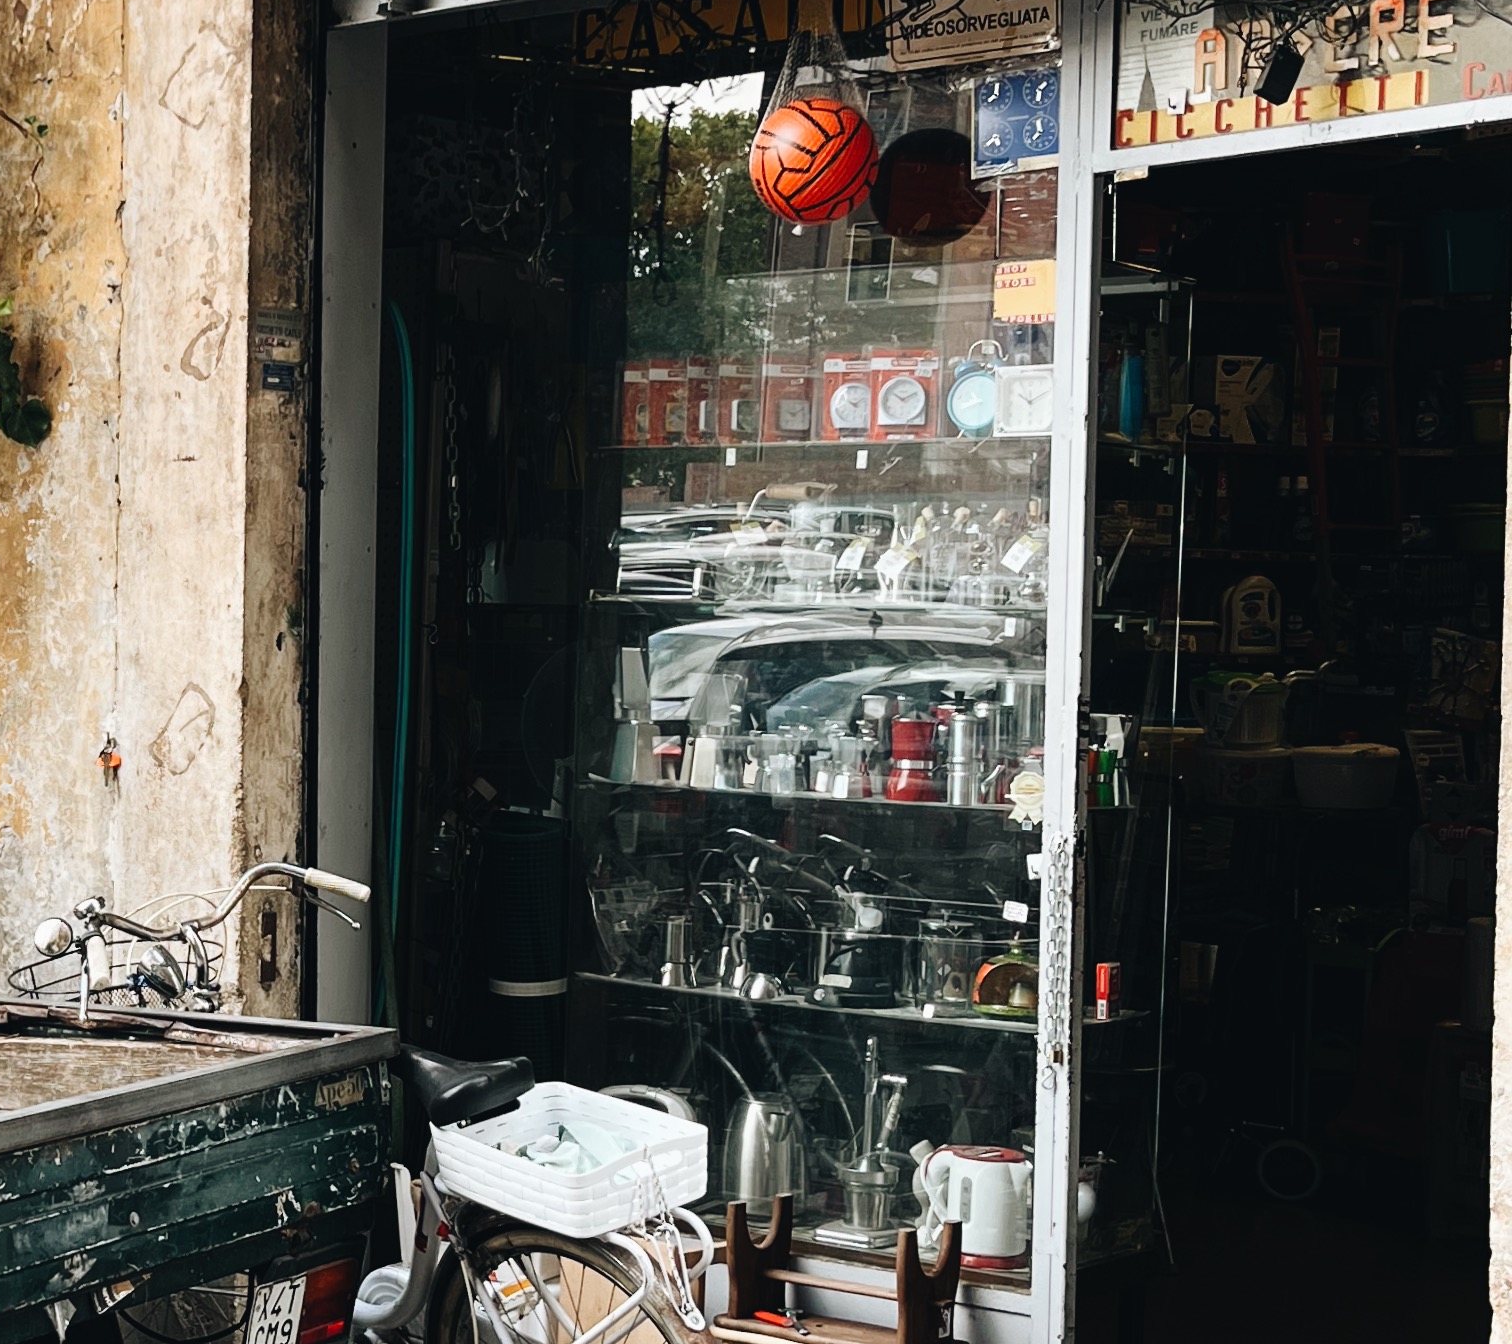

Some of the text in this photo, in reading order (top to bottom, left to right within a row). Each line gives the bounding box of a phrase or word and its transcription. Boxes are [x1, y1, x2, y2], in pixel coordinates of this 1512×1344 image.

[1140, 21, 1199, 42] FUMARE
[1115, 69, 1426, 149] CICCHETTI
[258, 1282, 301, 1323] X4T
